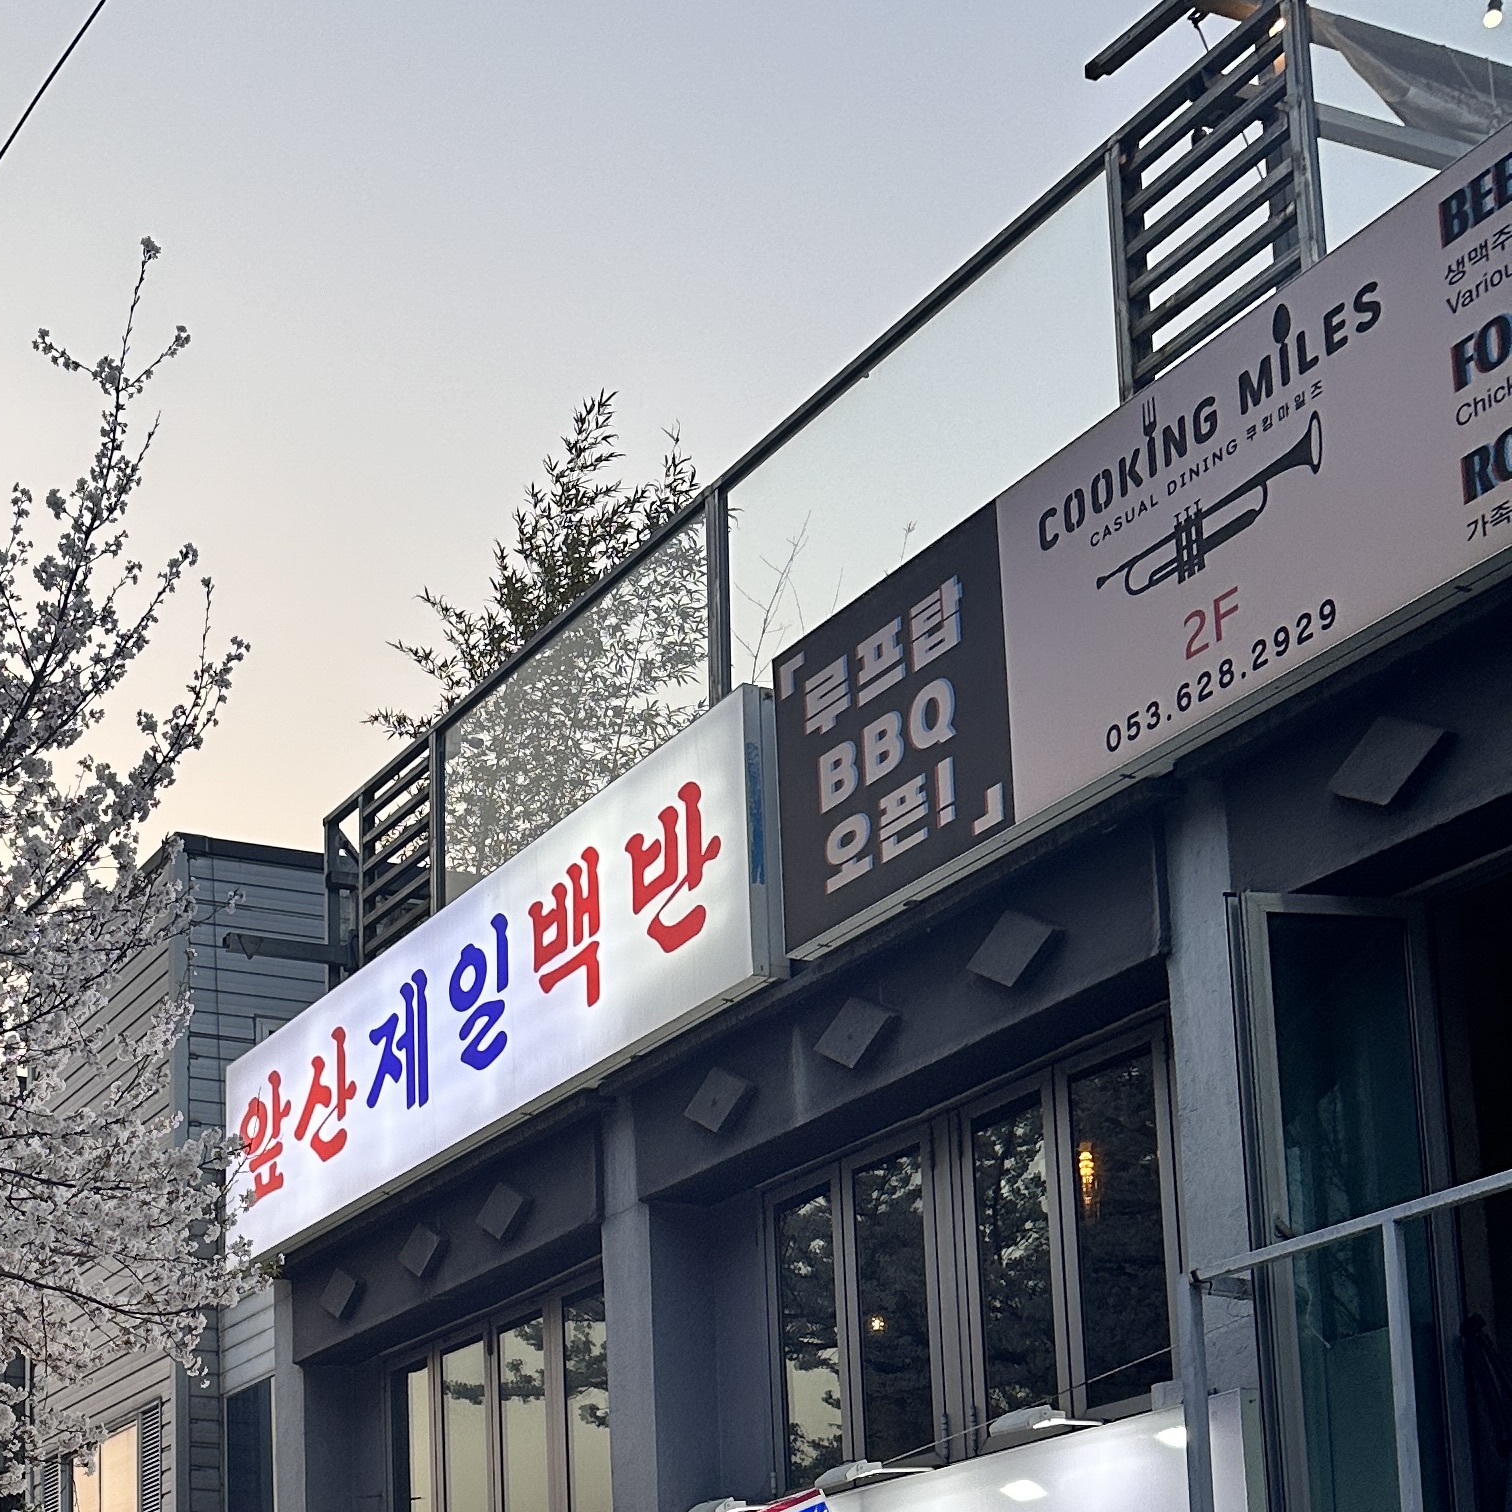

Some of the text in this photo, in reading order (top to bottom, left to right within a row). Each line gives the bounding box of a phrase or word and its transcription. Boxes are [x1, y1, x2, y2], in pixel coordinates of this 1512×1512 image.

[1038, 281, 1382, 551] COOKING MILES
[1090, 494, 1159, 547] CASUAL
[1166, 438, 1239, 497] DINING
[1105, 599, 1338, 753] 053.628.2929
[1183, 585, 1240, 660] 2F
[817, 677, 957, 815] BBQ
